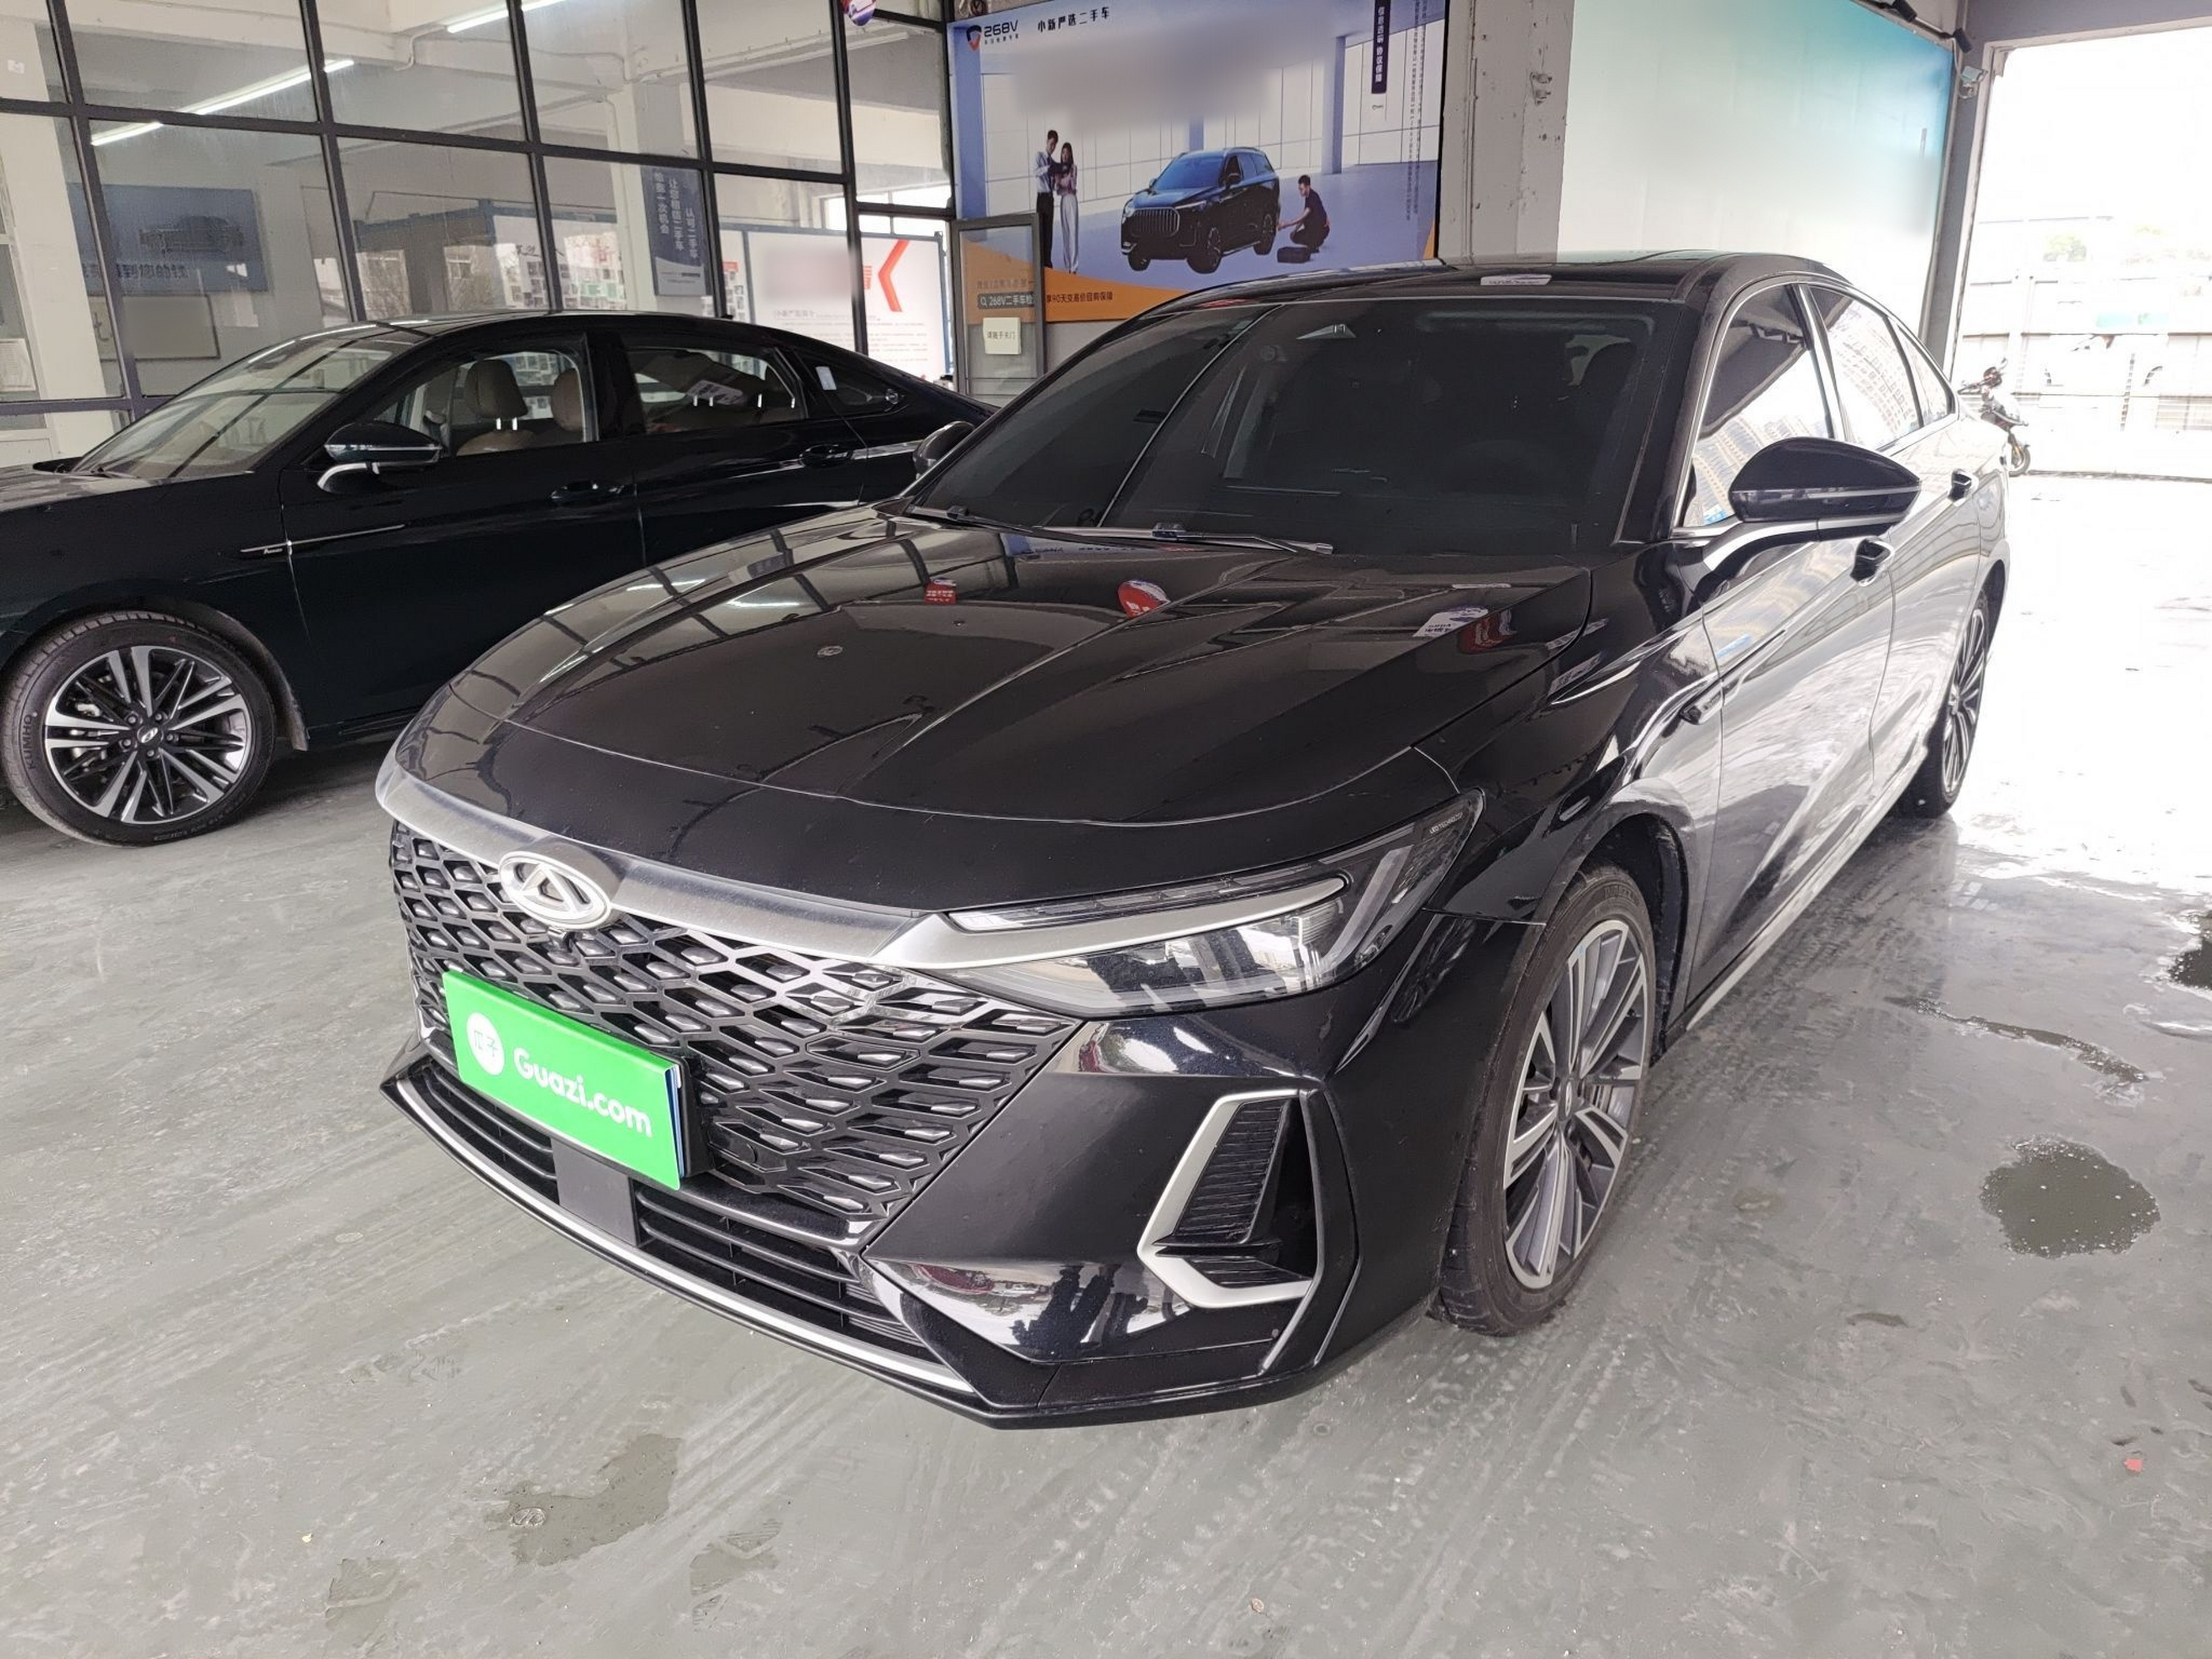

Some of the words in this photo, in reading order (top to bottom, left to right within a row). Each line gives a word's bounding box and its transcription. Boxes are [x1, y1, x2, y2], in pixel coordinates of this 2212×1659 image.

[984, 20, 1018, 37] 268V
[1038, 7, 1109, 32] 小新严选二手车
[22, 715, 36, 770] KUMHO
[513, 1047, 653, 1138] Guazi.com
